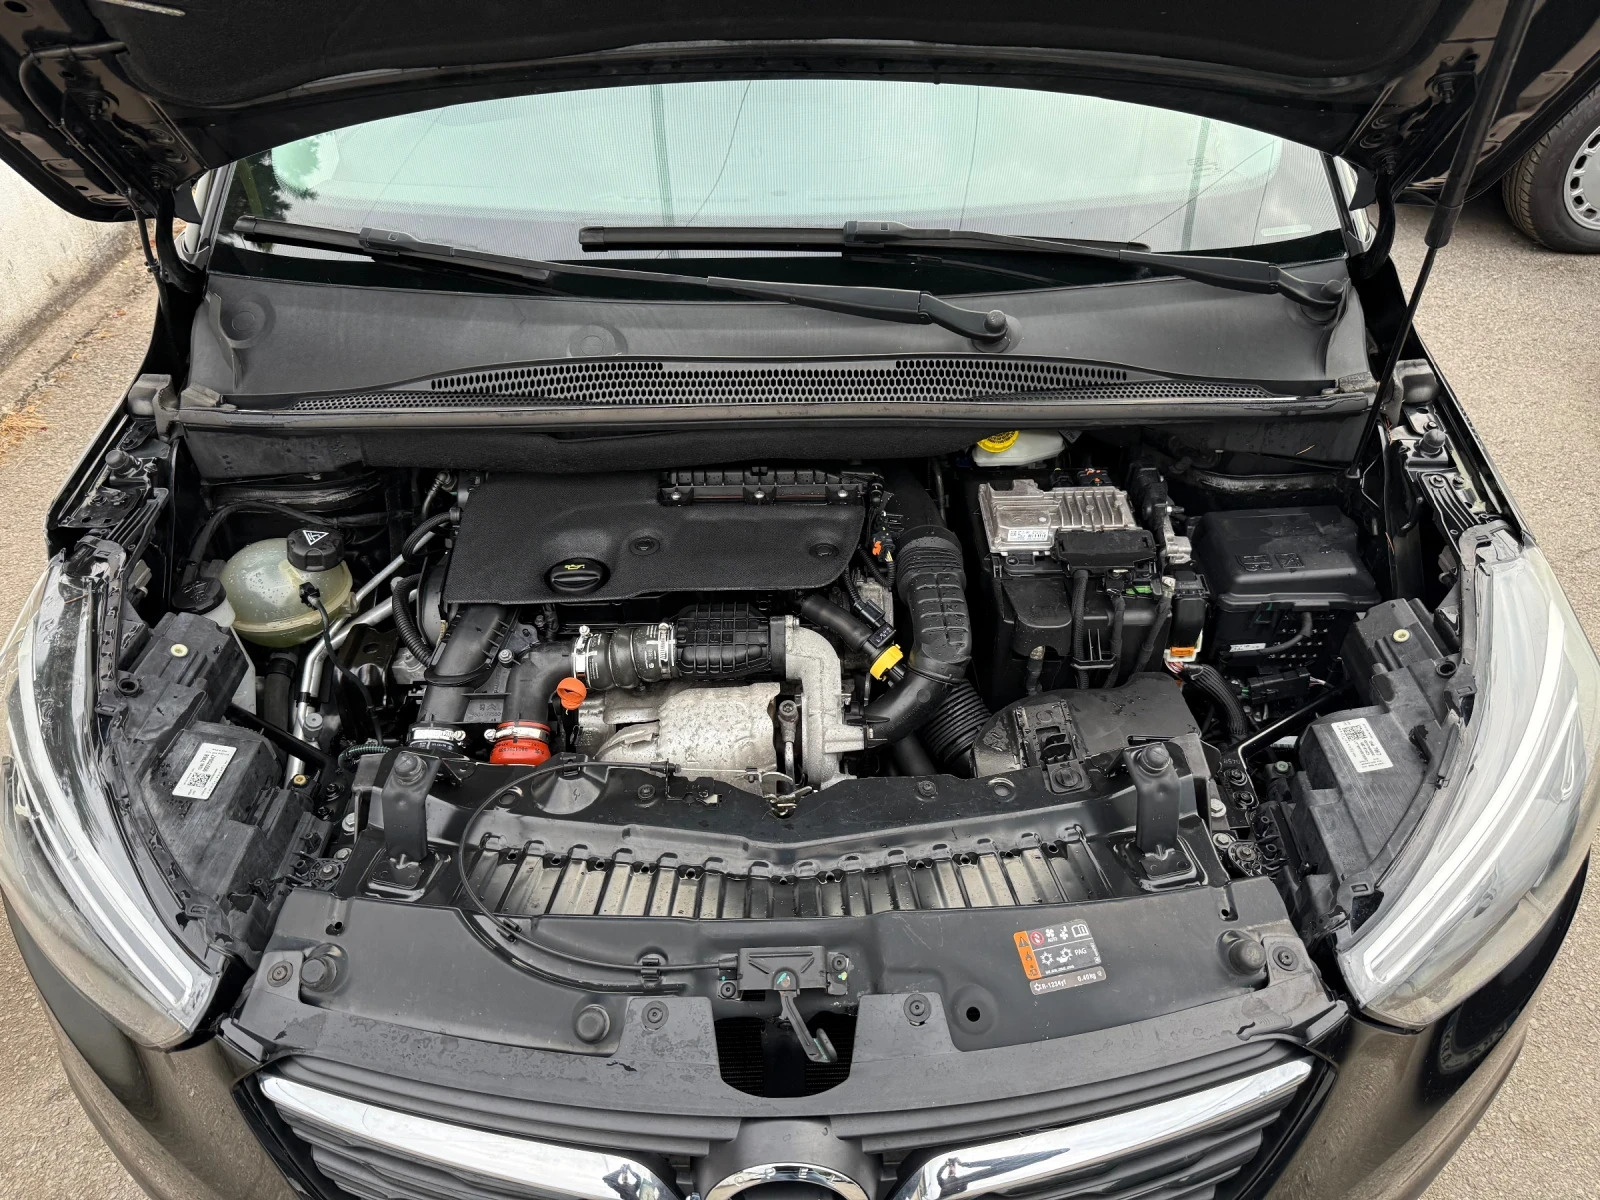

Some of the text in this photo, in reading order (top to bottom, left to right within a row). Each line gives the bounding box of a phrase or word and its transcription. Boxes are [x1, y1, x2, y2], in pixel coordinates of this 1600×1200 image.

[1074, 947, 1087, 956] PAG
[1041, 979, 1067, 990] R-1234yf
[734, 1167, 839, 1187] OPEL
